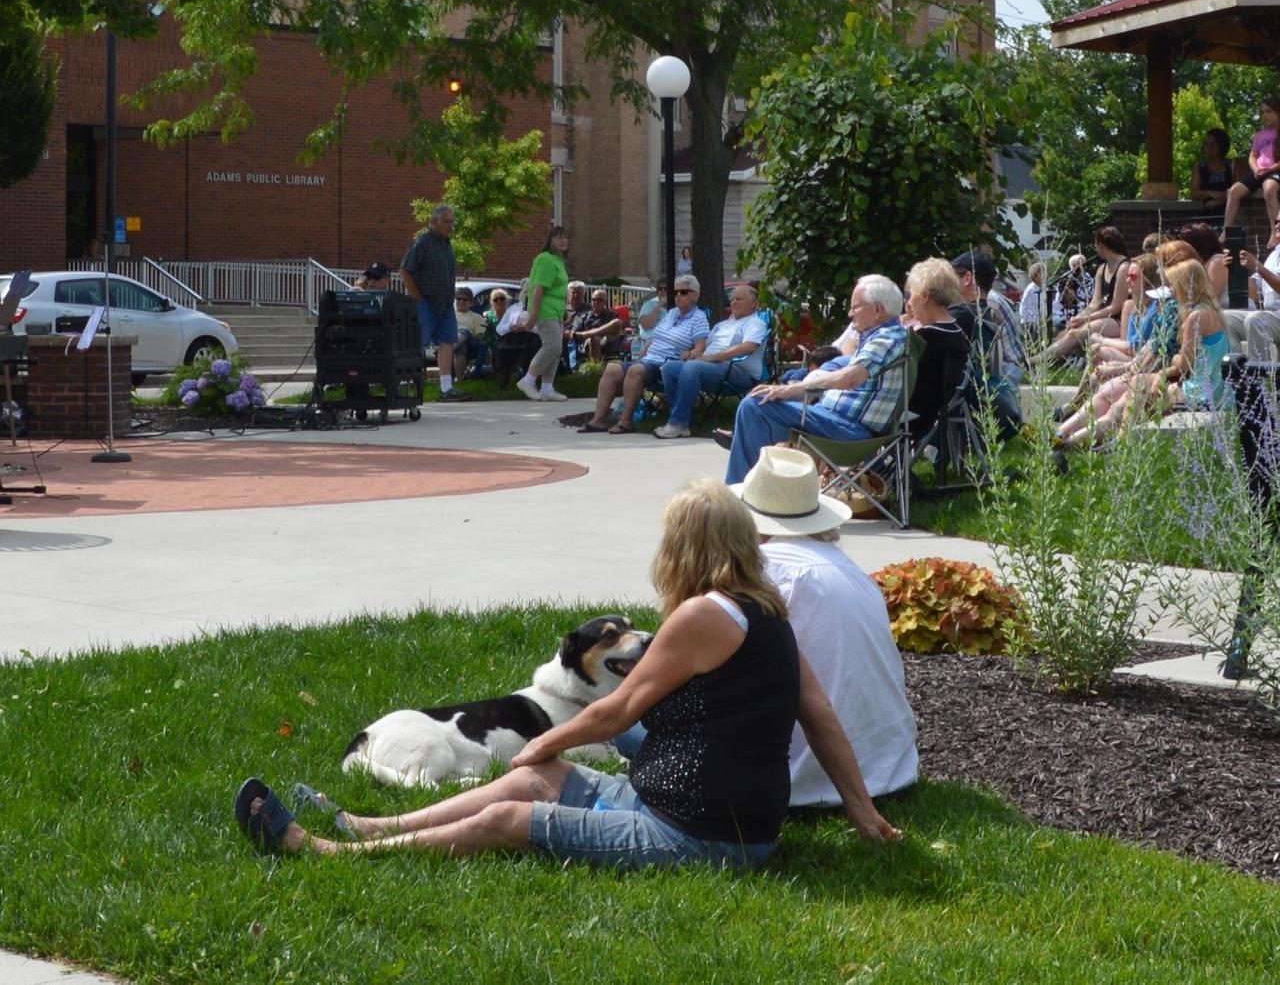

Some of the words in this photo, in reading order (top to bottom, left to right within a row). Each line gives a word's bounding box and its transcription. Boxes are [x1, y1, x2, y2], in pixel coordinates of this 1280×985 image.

[206, 171, 241, 182] ADAMS
[246, 173, 281, 184] PUBLIC
[286, 175, 325, 186] LIBRARY
